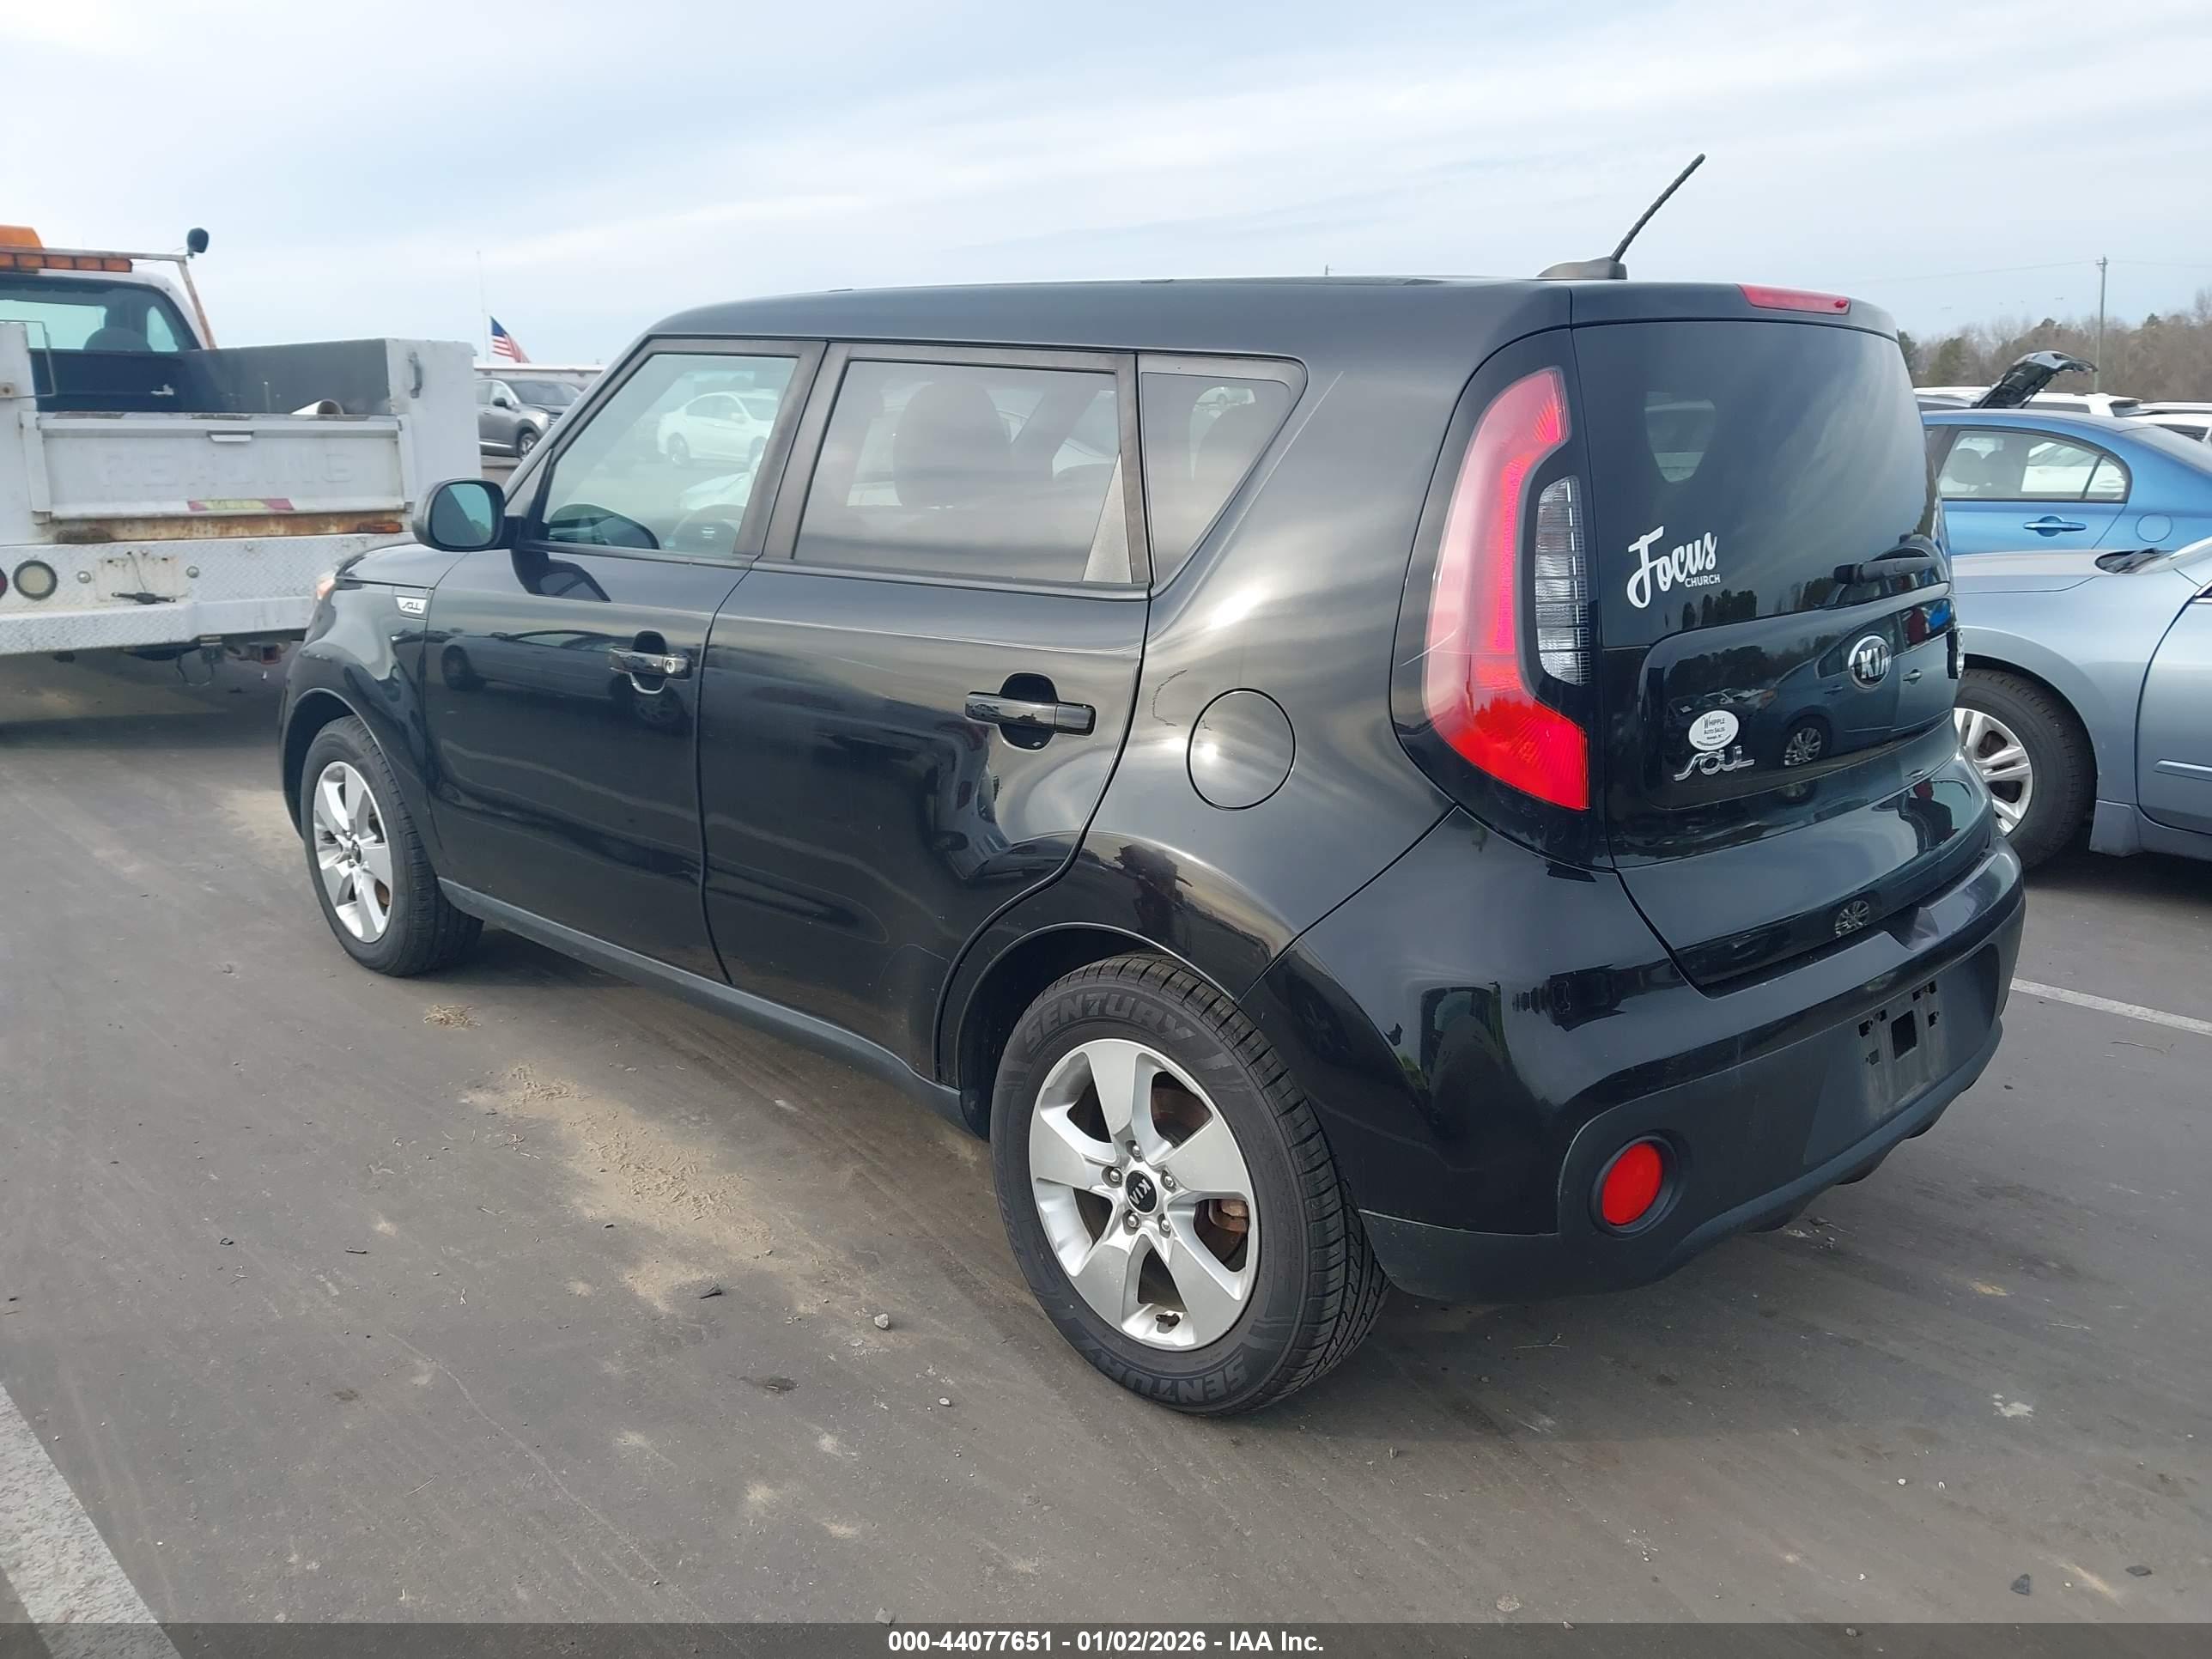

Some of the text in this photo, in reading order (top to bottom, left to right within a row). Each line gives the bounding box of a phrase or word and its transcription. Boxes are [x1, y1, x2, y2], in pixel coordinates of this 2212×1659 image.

[1627, 526, 1717, 608] Focus
[1685, 574, 1721, 587] CHURCH
[1859, 645, 1889, 678] KIA
[1674, 745, 1755, 781] SOUL
[1024, 992, 1196, 1045] SENTURY
[1130, 1178, 1152, 1205] KIA
